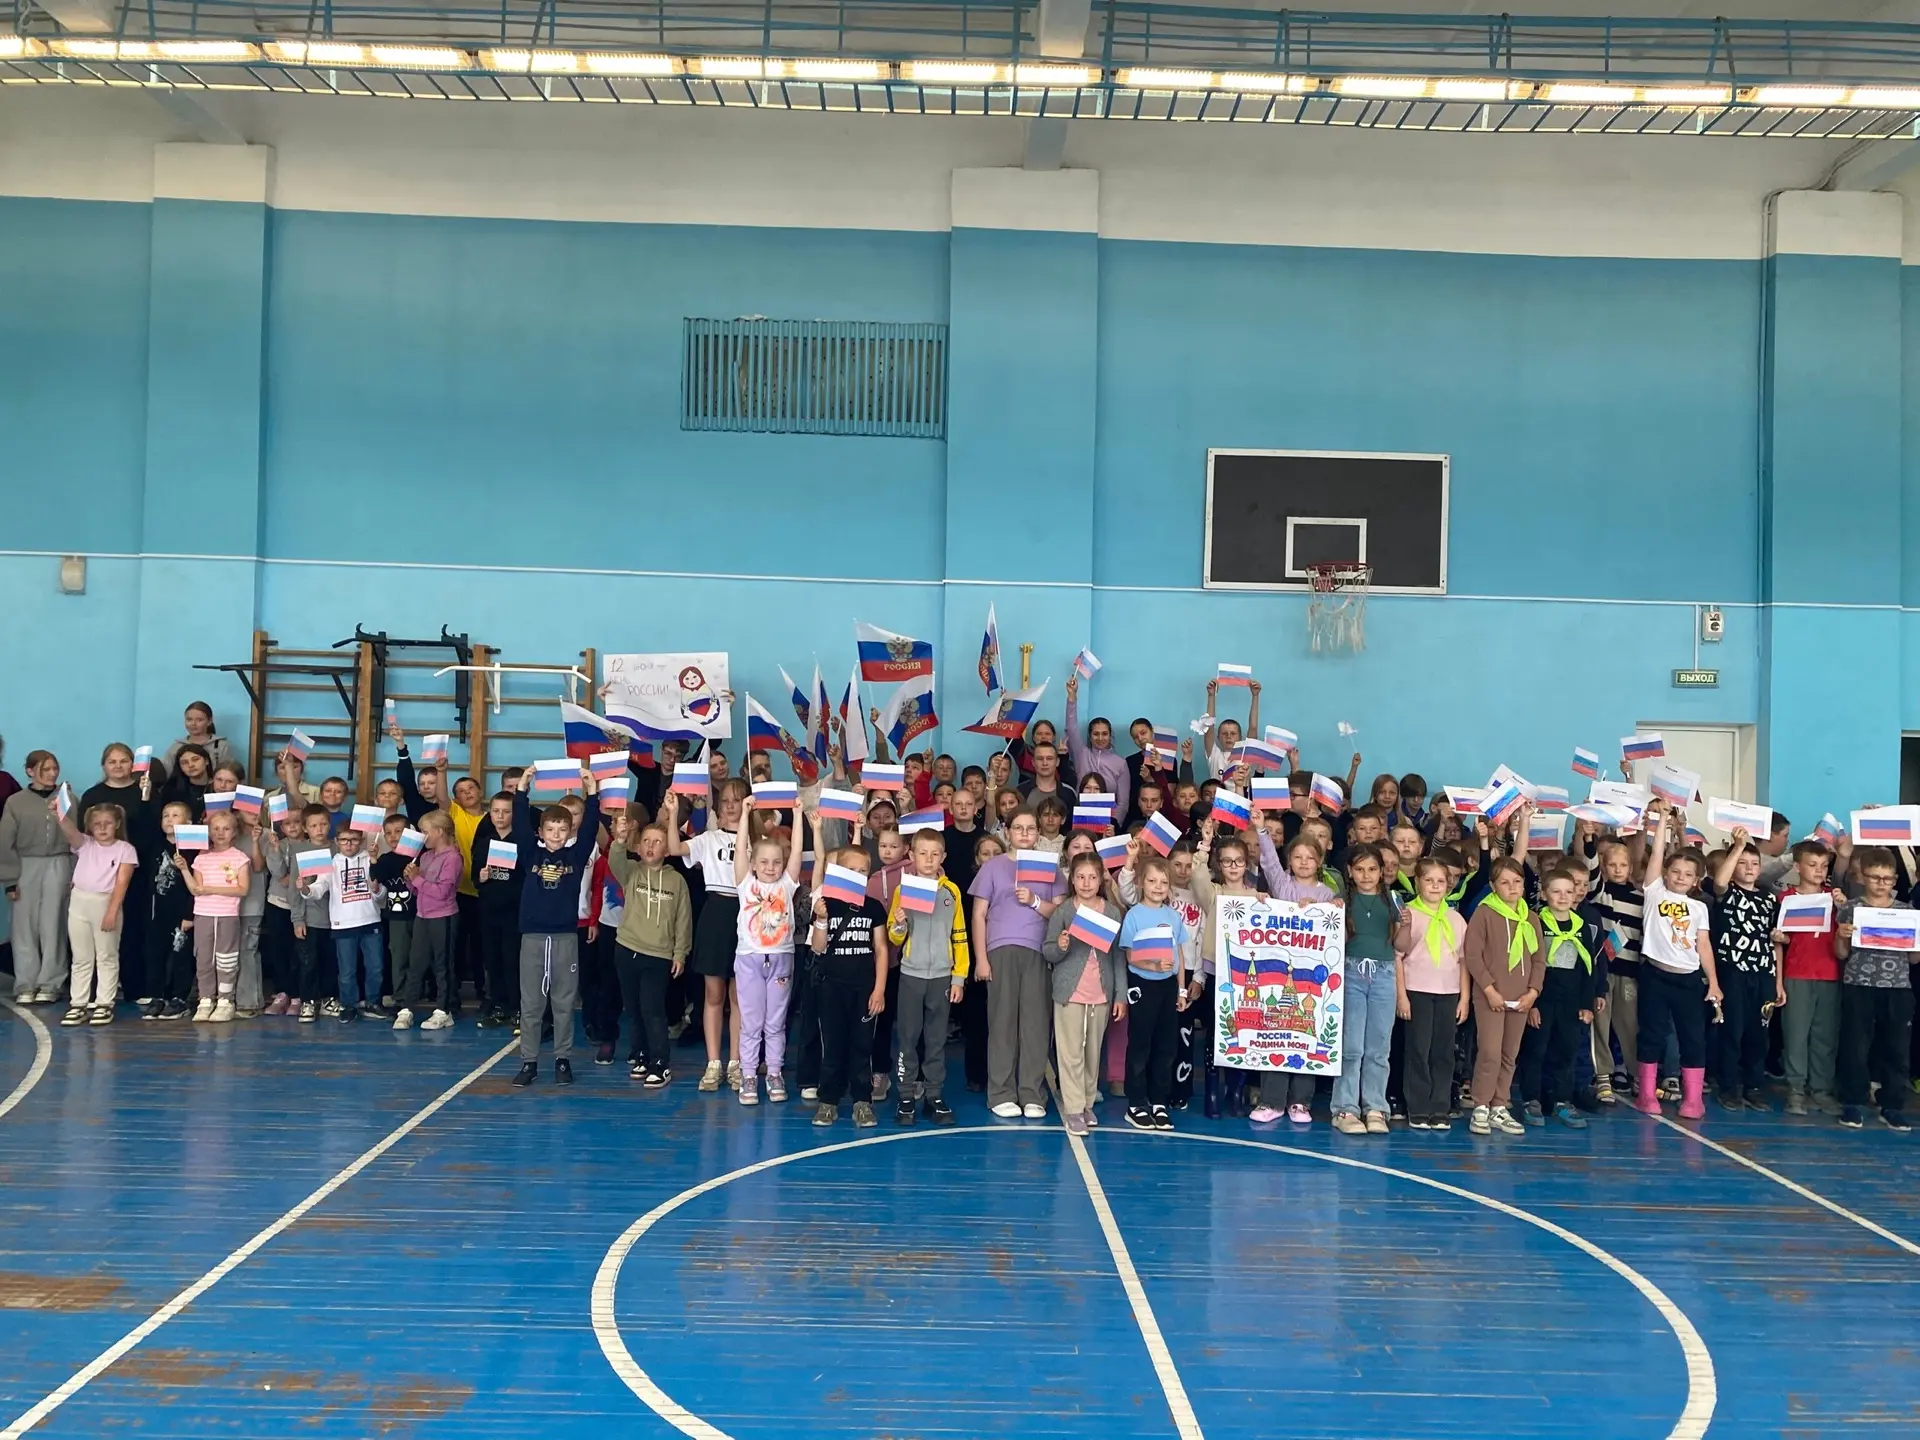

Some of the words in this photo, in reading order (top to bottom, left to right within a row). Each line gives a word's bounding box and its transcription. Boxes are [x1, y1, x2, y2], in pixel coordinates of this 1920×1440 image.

[610, 657, 626, 673] 12
[883, 661, 922, 671] РОССИЯ
[1680, 674, 1715, 683] ВЫХОД
[627, 684, 669, 697] РОССИИ!
[1250, 914, 1262, 927] С
[1266, 915, 1314, 932] ДНЁМ
[1238, 928, 1326, 952] РОССИИ!
[1256, 1032, 1292, 1040] РОССИЯ
[1249, 1040, 1286, 1049] РОДИНА
[1287, 1040, 1310, 1051] МОЯ!
